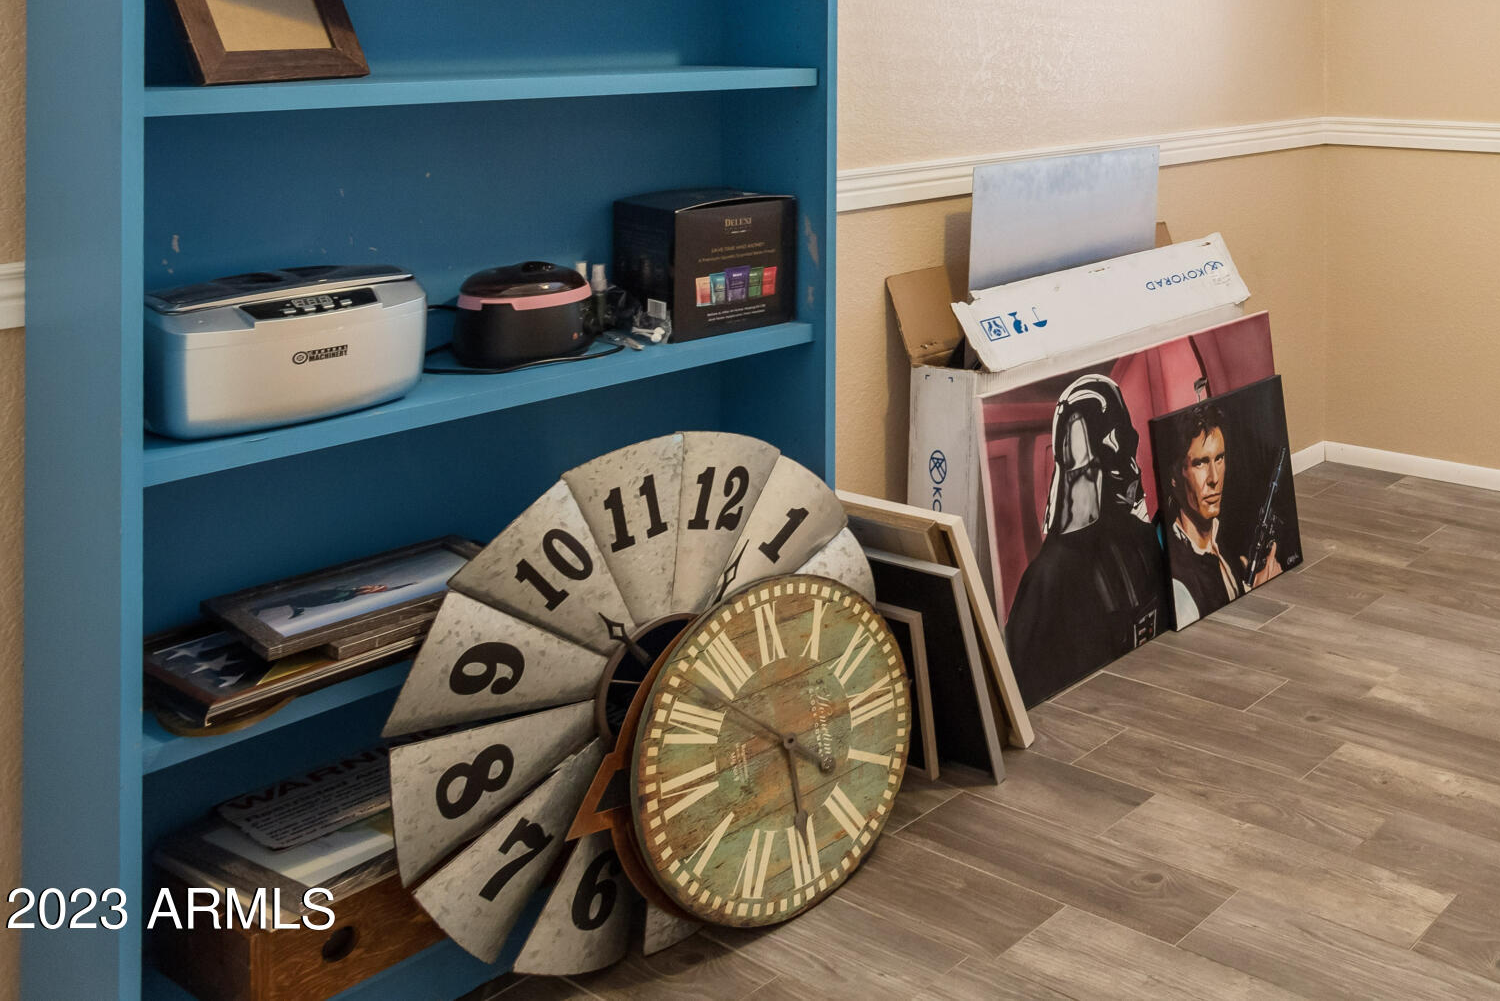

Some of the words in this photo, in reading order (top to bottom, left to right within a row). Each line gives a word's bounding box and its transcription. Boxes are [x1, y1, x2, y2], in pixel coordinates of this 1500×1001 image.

[1145, 267, 1205, 291] KOYORAD
[308, 349, 348, 362] MACHINERY
[603, 474, 668, 553] 11
[687, 465, 750, 531] 12
[514, 529, 594, 612] 10
[758, 507, 810, 564] 1
[449, 641, 525, 696] 9
[436, 744, 514, 820] 8
[478, 817, 554, 902] 7
[571, 849, 622, 931] 6
